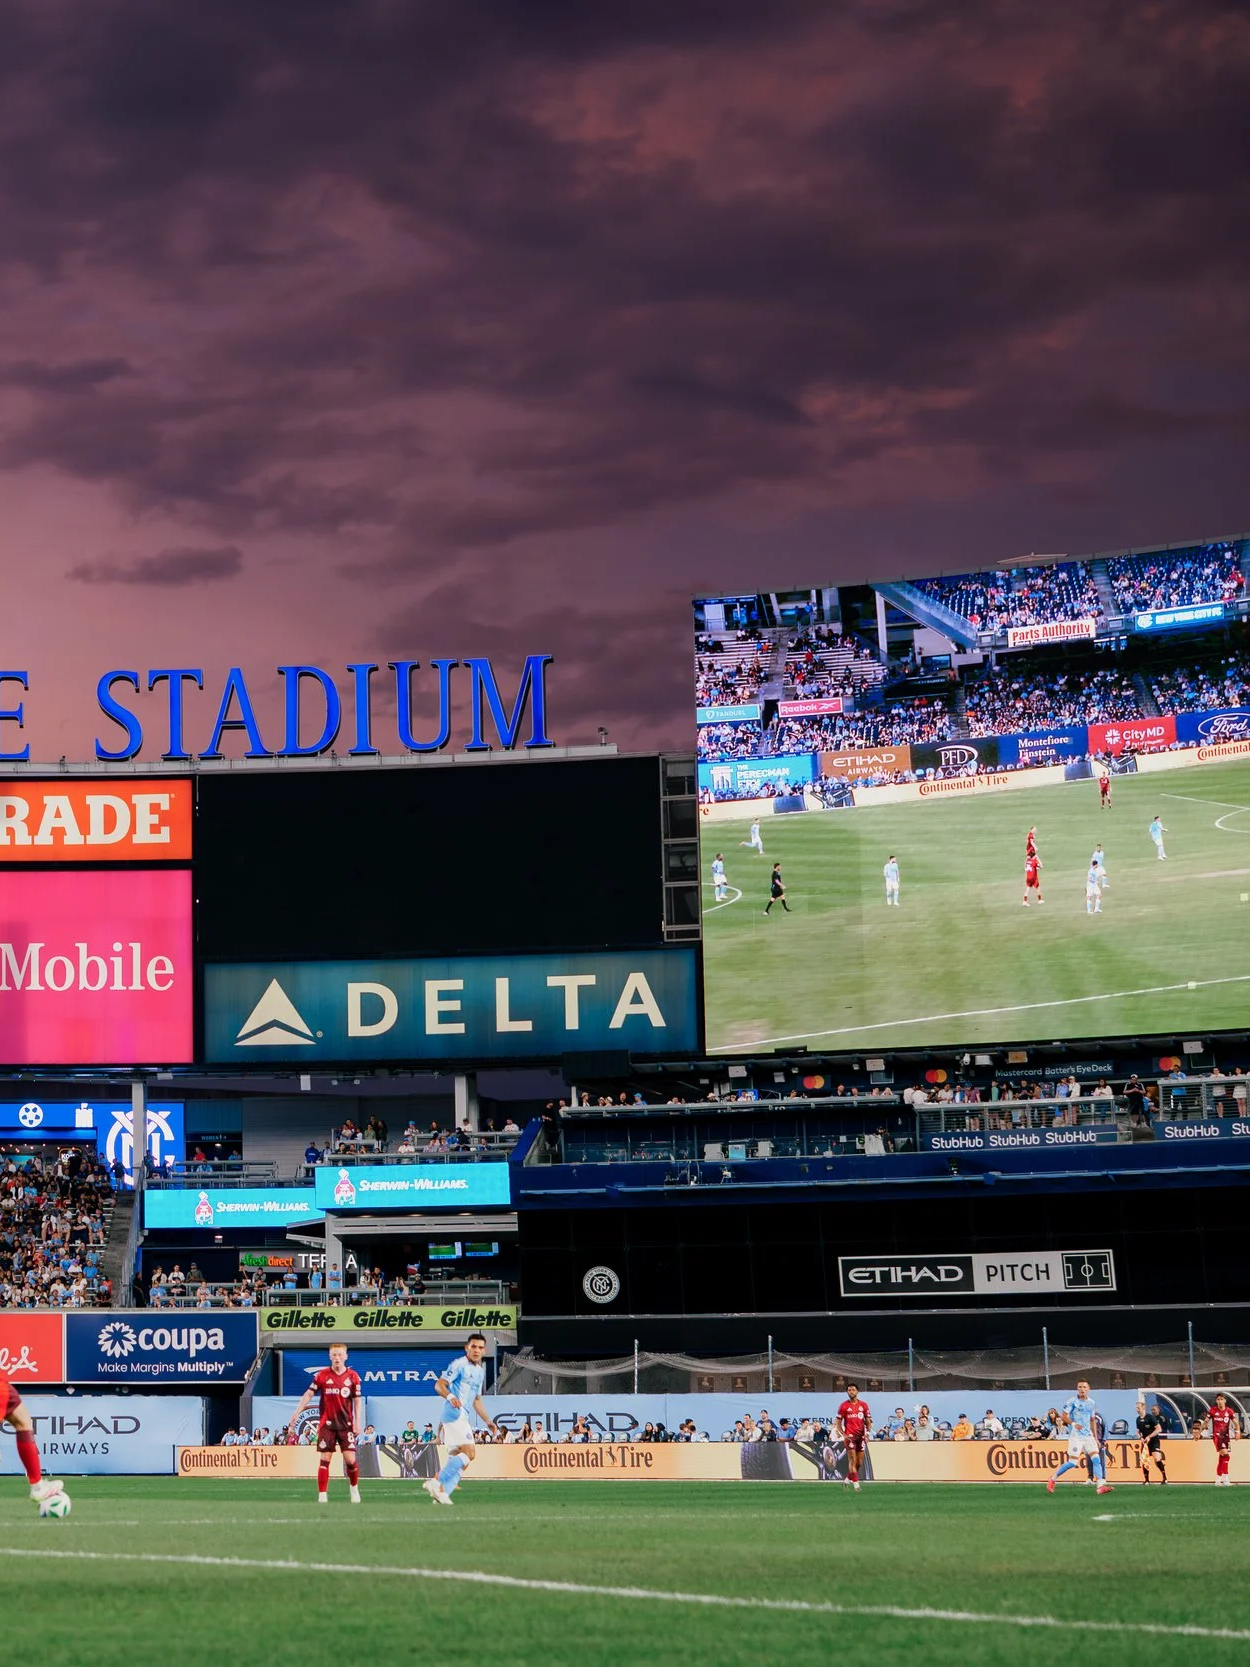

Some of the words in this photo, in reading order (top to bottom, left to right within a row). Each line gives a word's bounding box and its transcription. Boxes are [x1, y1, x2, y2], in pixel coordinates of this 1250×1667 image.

[1012, 628, 1040, 641] Parts
[1042, 622, 1090, 638] Authority
[94, 654, 555, 762] STADIUM
[781, 704, 818, 714] Reebok
[1210, 716, 1248, 733] Ford
[1018, 735, 1070, 748] Montefiore
[832, 753, 896, 767] ETIHAD
[941, 750, 969, 766] PFD
[1019, 747, 1057, 758] Einstein
[847, 765, 884, 776] AIRWAYS
[919, 777, 976, 796] Continental
[985, 775, 1008, 786] Tire
[347, 972, 666, 1037] DELTA
[995, 1069, 1043, 1077] Mastercard
[1044, 1066, 1076, 1075] Batter's
[931, 1136, 984, 1149] StubHub
[989, 1133, 1040, 1147] StubHub
[1045, 1130, 1097, 1144] StubHub
[1164, 1124, 1220, 1138] StubHub
[298, 1254, 358, 1268] TERA
[848, 1265, 964, 1284] ETIHAD
[986, 1263, 1050, 1282] PITCH
[266, 1310, 336, 1328] Gillette
[353, 1309, 424, 1328] Gillette
[440, 1309, 512, 1327] Gillette
[138, 1327, 225, 1357] coupa
[98, 1362, 128, 1373] Make
[130, 1362, 175, 1375] Margins
[358, 1370, 448, 1382] MTRA
[293, 1412, 306, 1429] NEW
[492, 1411, 638, 1432] ETIHAD
[347, 1431, 355, 1442] 8
[38, 1442, 110, 1455] IRWAYS
[179, 1449, 241, 1473] Continental
[252, 1447, 278, 1468] Tire
[523, 1446, 605, 1474] Continental
[617, 1445, 653, 1468] Tire
[986, 1444, 1090, 1475] Continena
[1115, 1443, 1166, 1469] Ti
